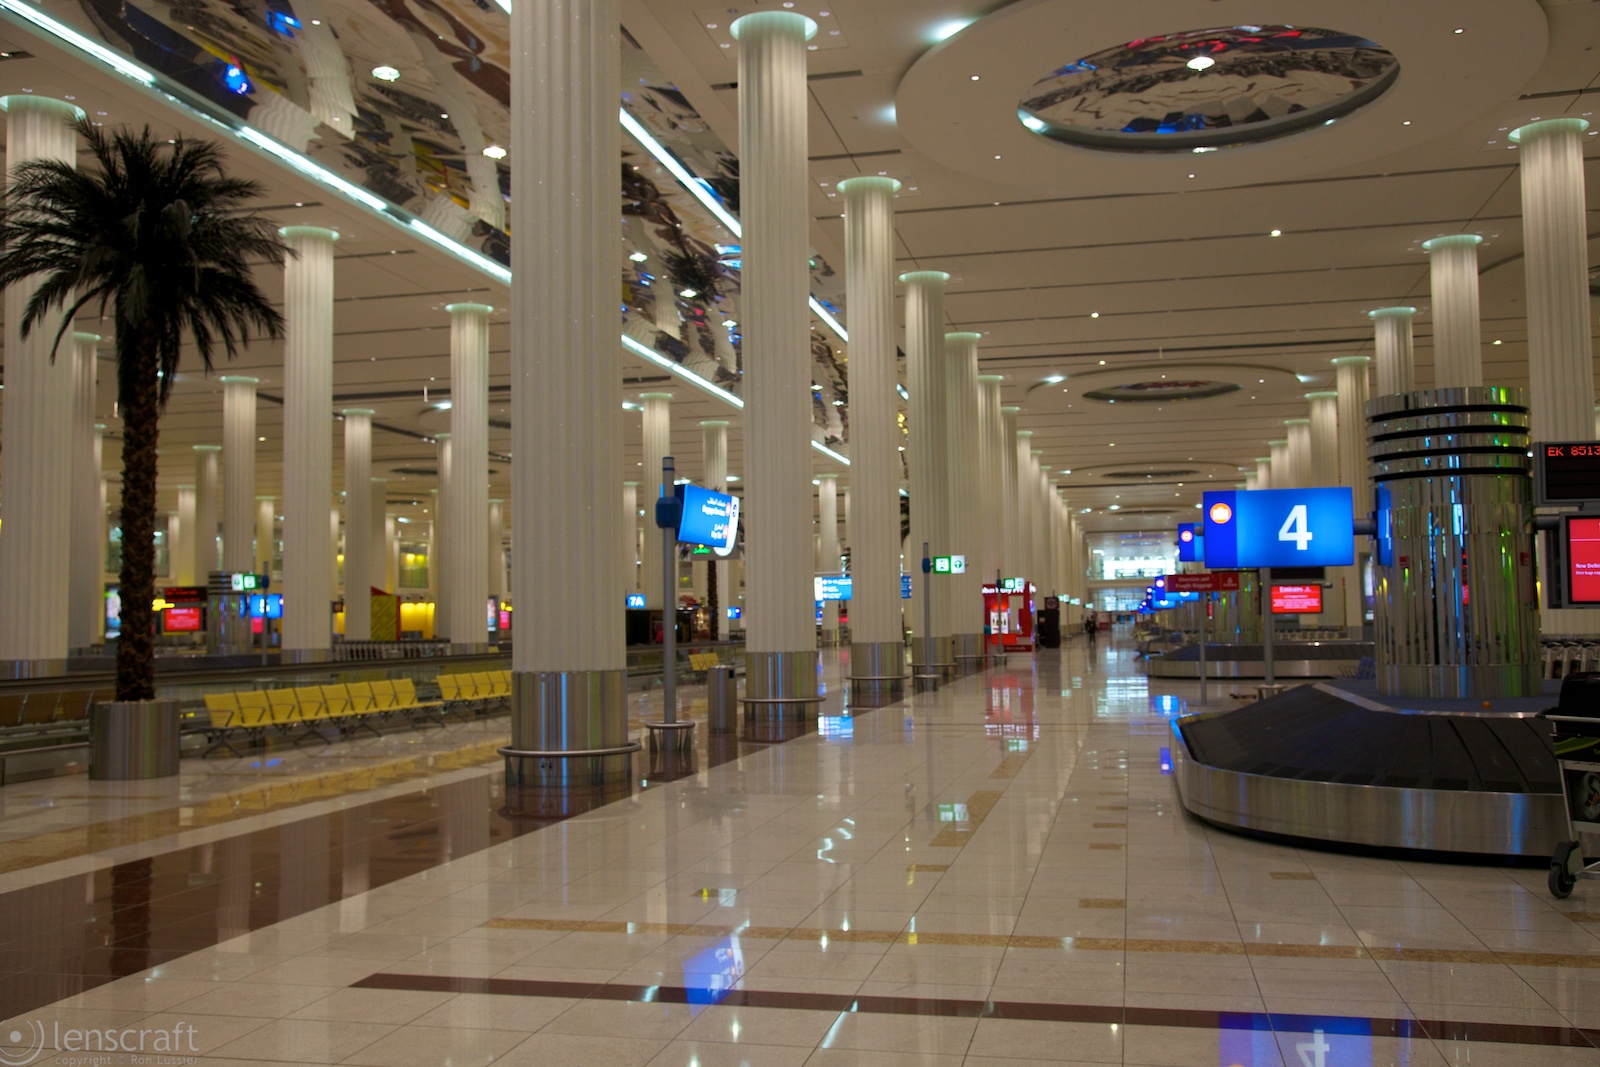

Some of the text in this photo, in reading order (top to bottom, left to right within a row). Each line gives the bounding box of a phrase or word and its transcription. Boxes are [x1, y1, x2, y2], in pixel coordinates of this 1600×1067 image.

[1548, 446, 1564, 457] EK
[1278, 504, 1313, 551] 4
[629, 596, 644, 607] 7A
